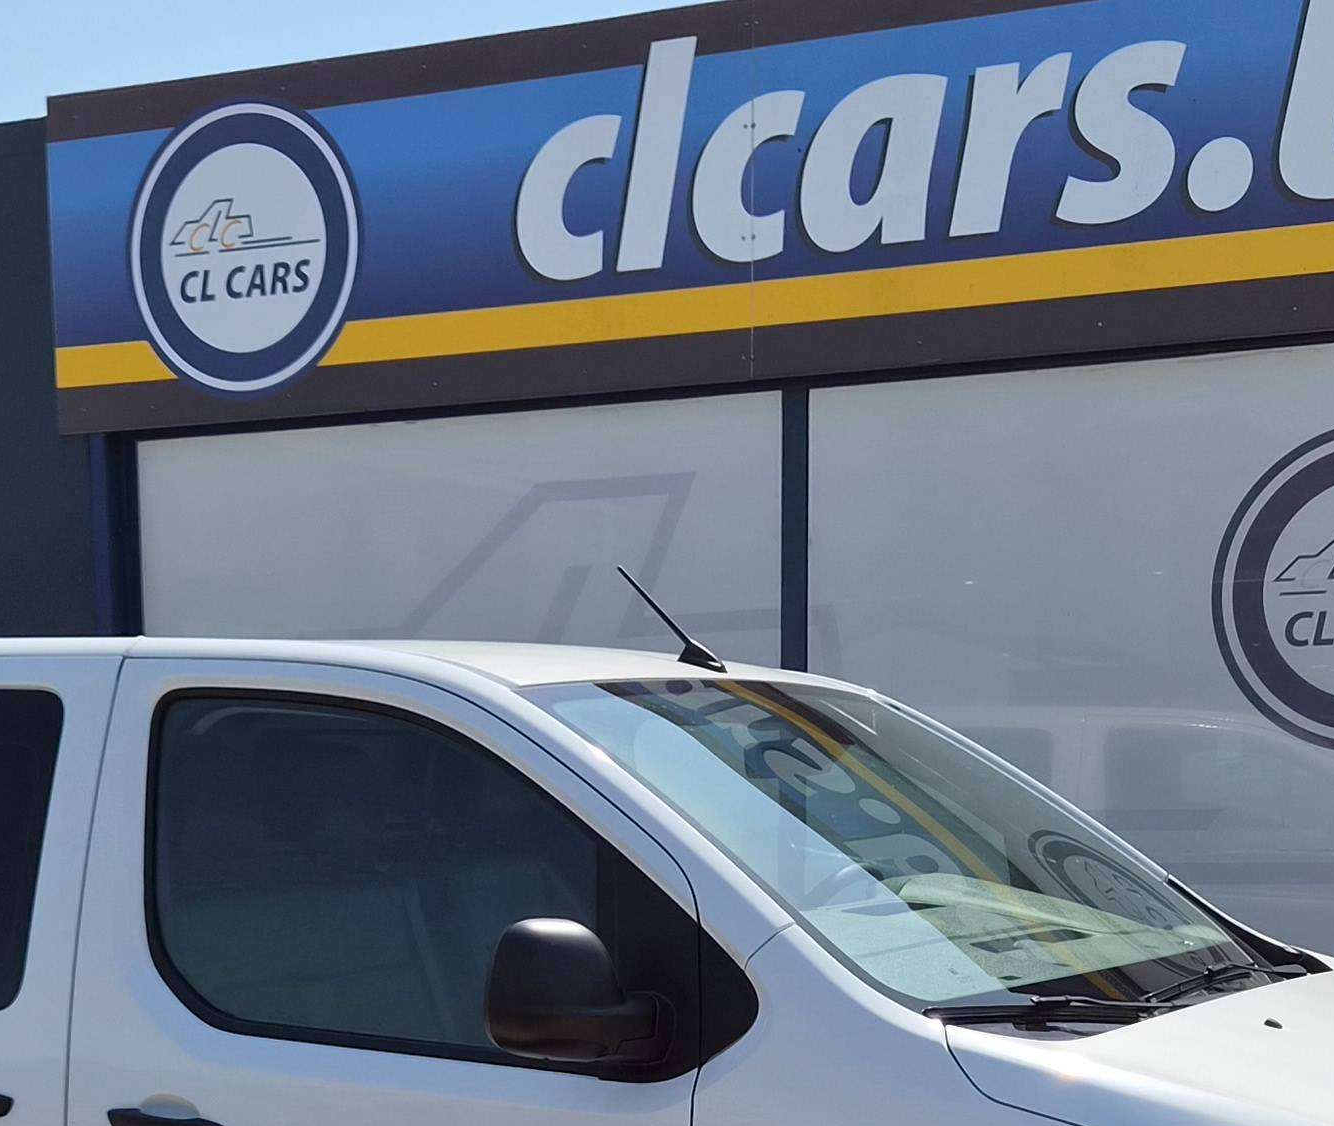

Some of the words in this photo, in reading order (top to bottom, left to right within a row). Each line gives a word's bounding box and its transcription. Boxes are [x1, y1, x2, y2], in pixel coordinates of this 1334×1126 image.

[180, 270, 216, 303] CL
[226, 259, 311, 298] CARS
[1284, 610, 1334, 647] CL
